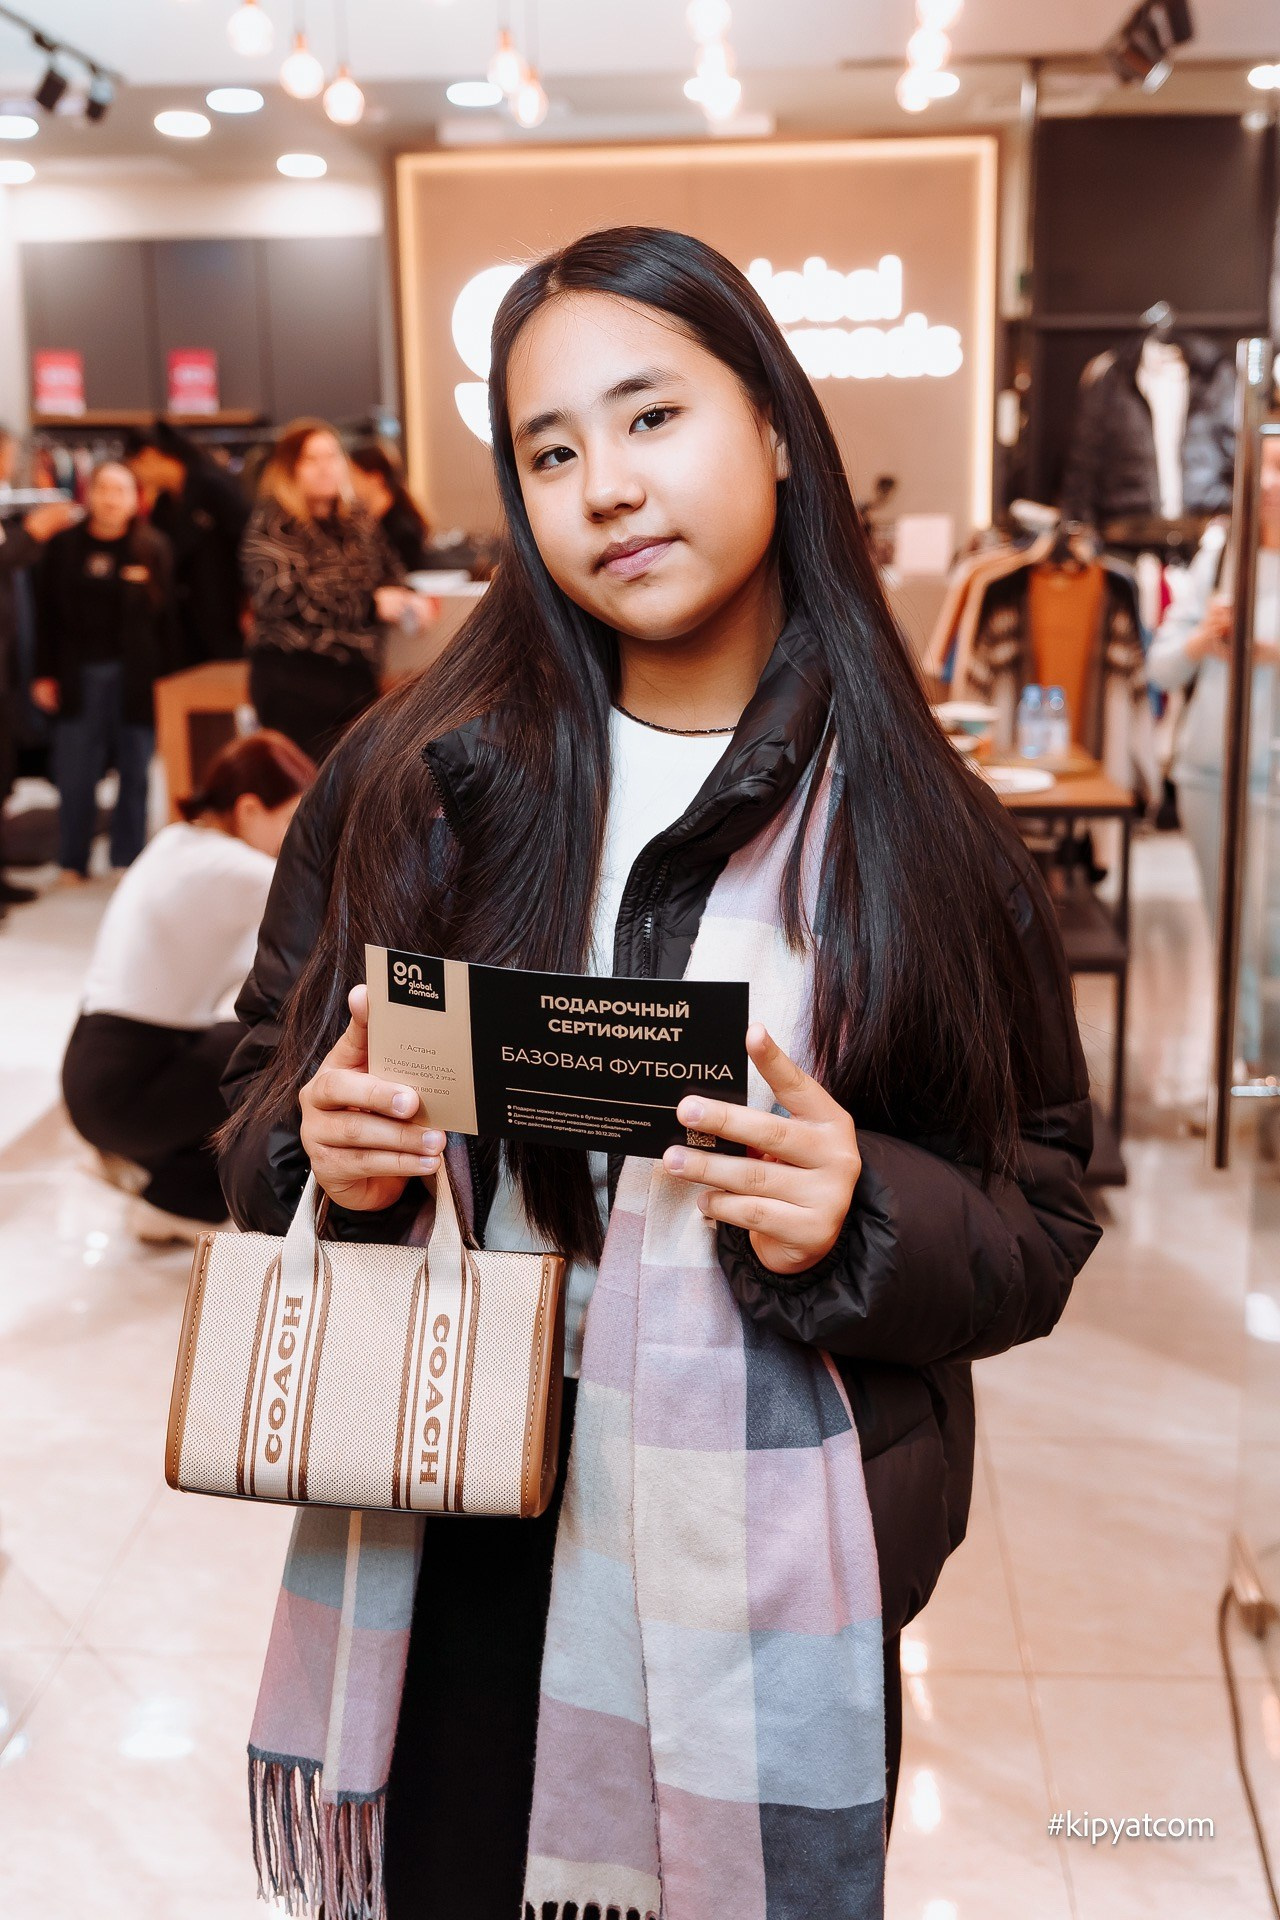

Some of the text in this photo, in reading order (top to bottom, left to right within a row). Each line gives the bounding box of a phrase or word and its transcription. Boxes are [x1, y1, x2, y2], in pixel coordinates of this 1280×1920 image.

[408, 980, 433, 991] global
[408, 989, 439, 999] nomads
[540, 995, 690, 1019] ПОДАРОЧНЫЙ
[548, 1019, 683, 1042] СЕРТИФИКАТ
[407, 1044, 437, 1055] Астана
[397, 1060, 430, 1070] АБУ-ДАБИ
[431, 1065, 456, 1074] ПЛАЗА,
[501, 1046, 734, 1080] БАЗОВАЯ ФУТБОЛКА
[535, 1116, 566, 1124] сертификат
[604, 1116, 626, 1124] GLOBAL
[626, 1119, 652, 1127] NOMADS
[264, 1295, 304, 1464] COACH
[419, 1313, 451, 1485] COACH
